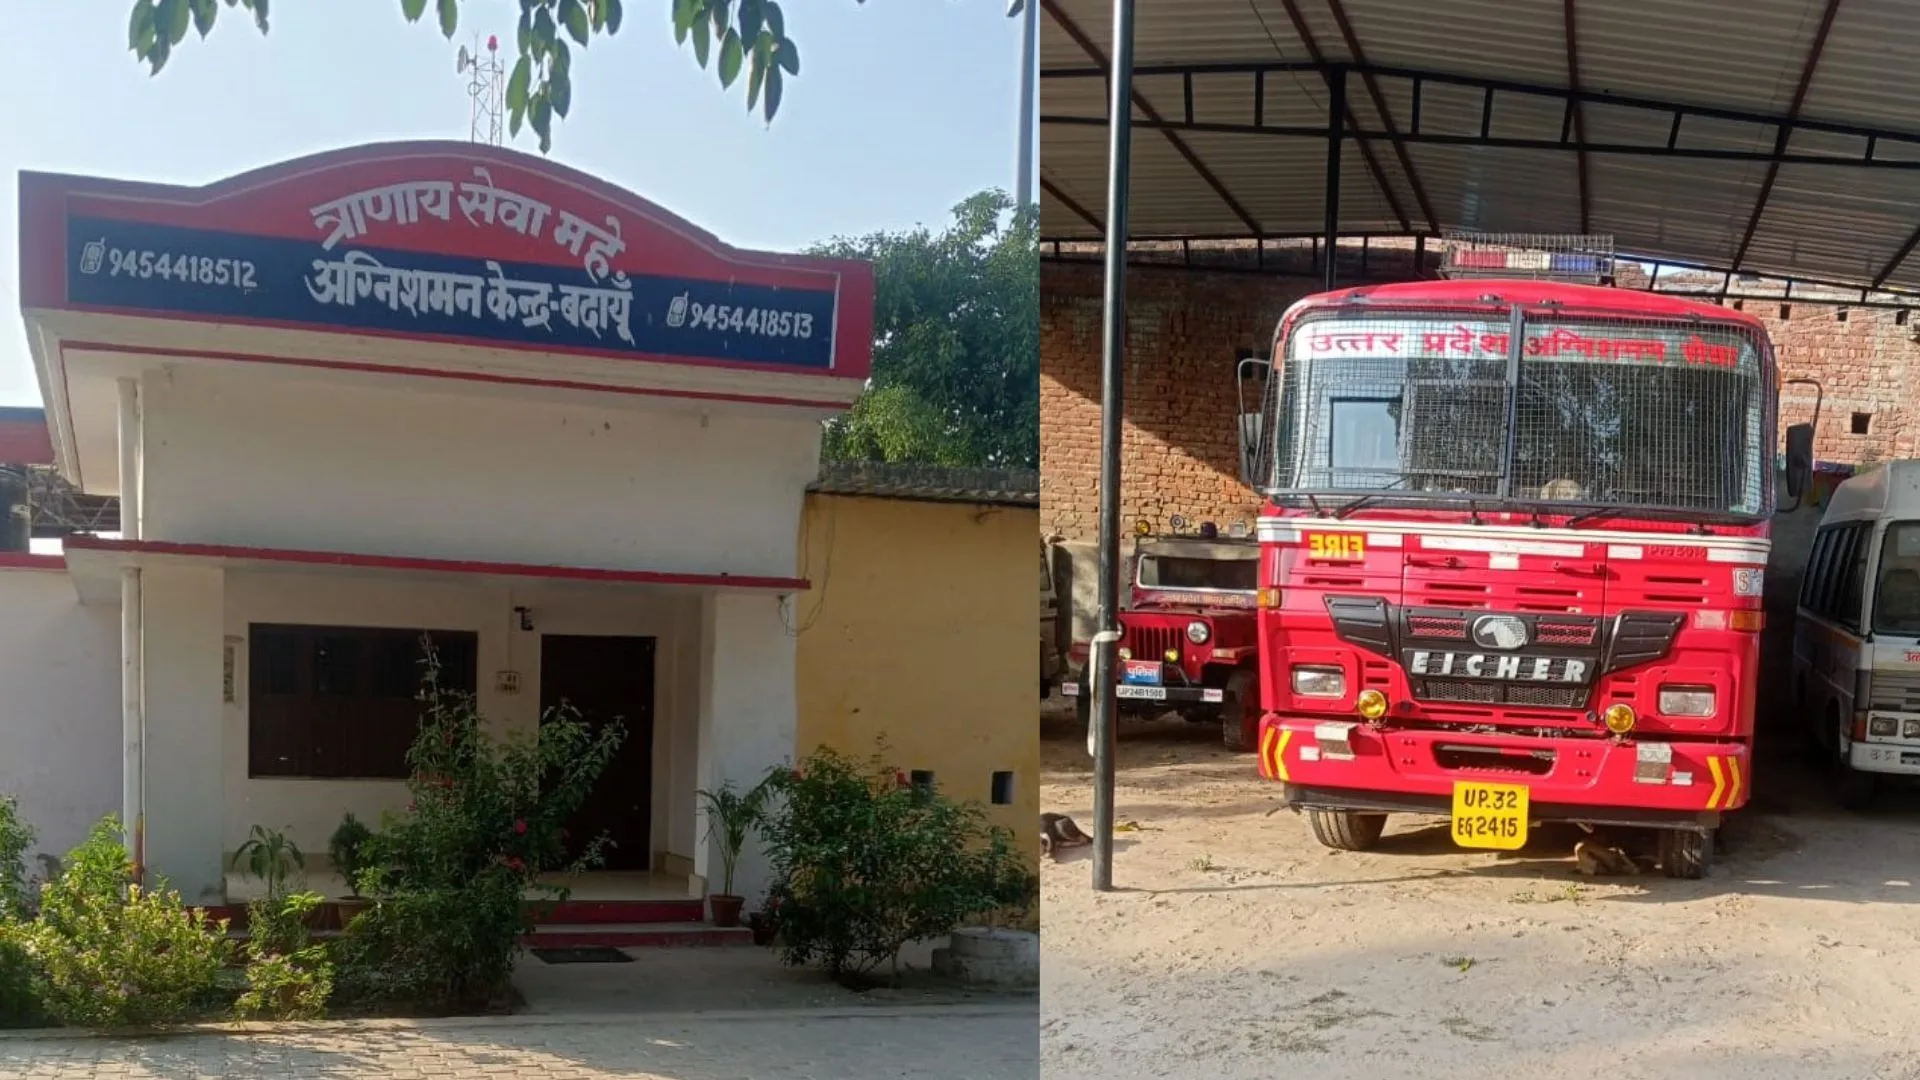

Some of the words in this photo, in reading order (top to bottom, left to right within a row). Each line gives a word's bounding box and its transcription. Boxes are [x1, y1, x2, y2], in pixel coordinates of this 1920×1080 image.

[309, 180, 454, 251] त्राणाय
[457, 166, 551, 238] सेवा
[109, 248, 258, 288] 9454418512
[304, 250, 484, 319] अग्निशमन
[690, 302, 814, 339] 9454418513
[1304, 332, 1404, 353] उत्तर
[1422, 325, 1511, 354] प्रदेश
[1523, 327, 1666, 364] अग्निशमन
[1679, 332, 1739, 369] सेवा
[1411, 651, 1586, 683] EICHER
